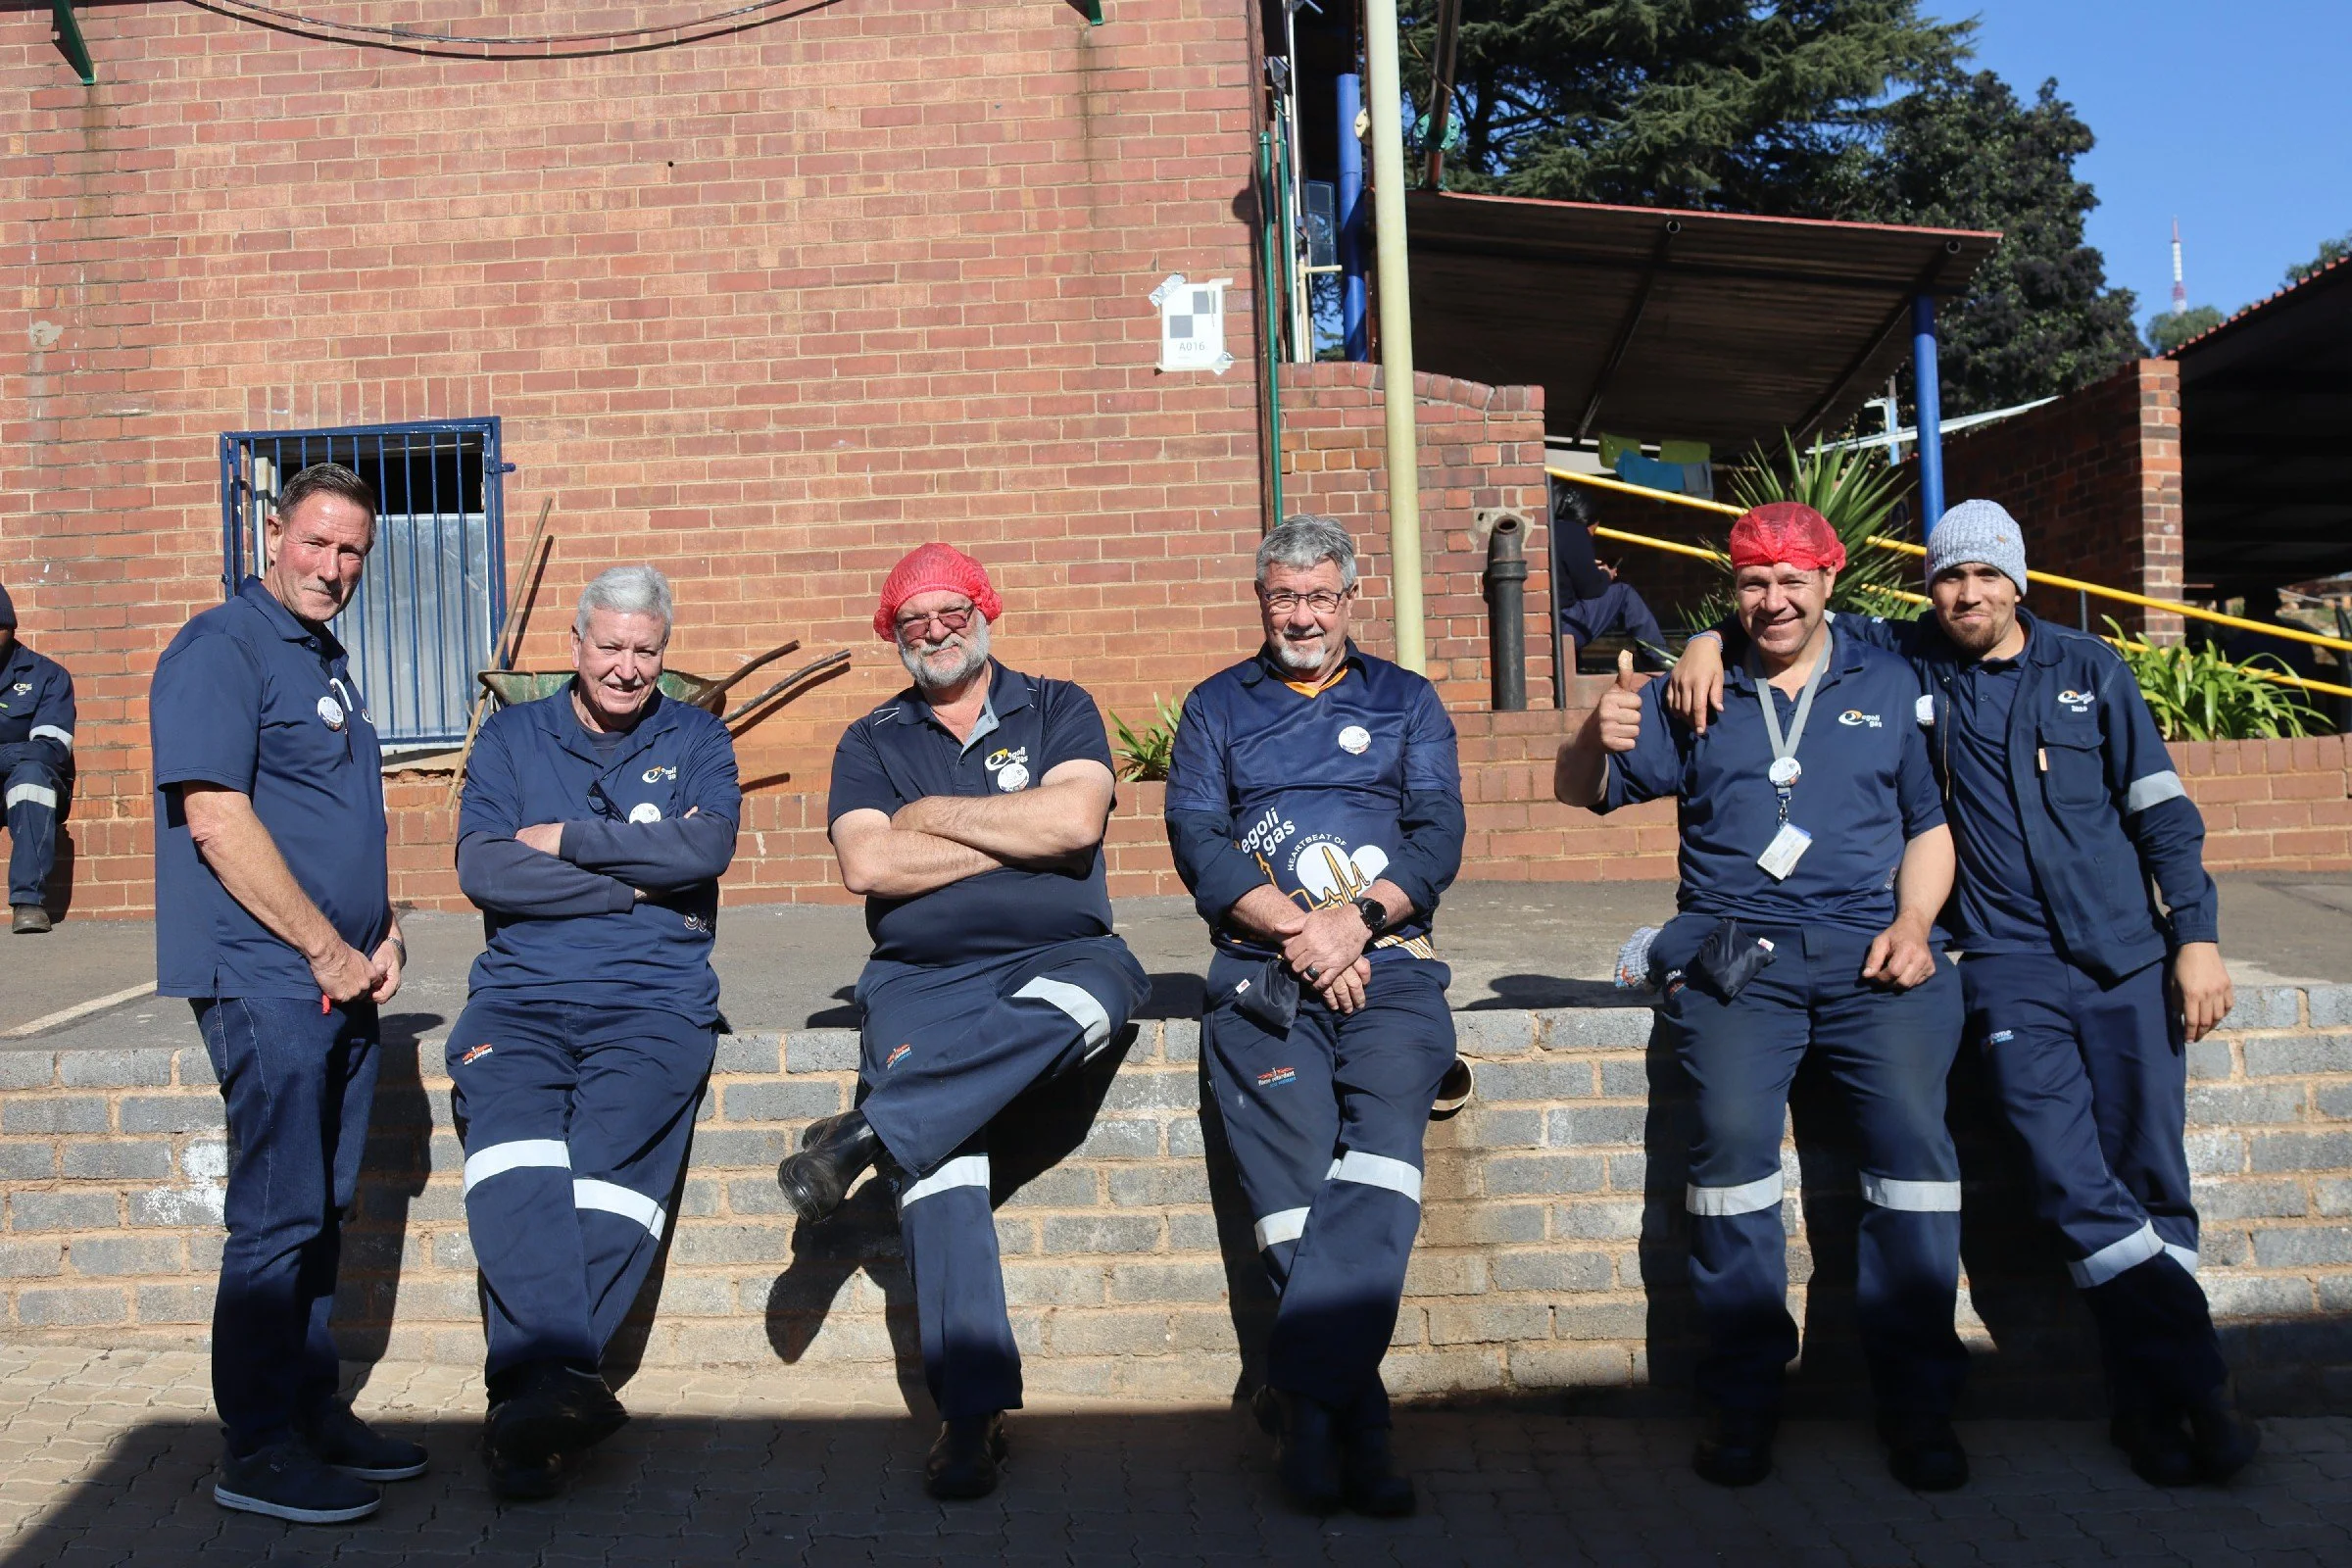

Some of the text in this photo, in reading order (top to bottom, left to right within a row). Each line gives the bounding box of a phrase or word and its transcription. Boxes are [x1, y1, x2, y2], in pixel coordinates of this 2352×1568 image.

[1179, 341, 1205, 352] A016
[1007, 746, 1025, 760] egoli
[1241, 807, 1280, 855] egoli
[1262, 820, 1296, 858] gas
[1287, 833, 1348, 871] HEARTBEAT OF
